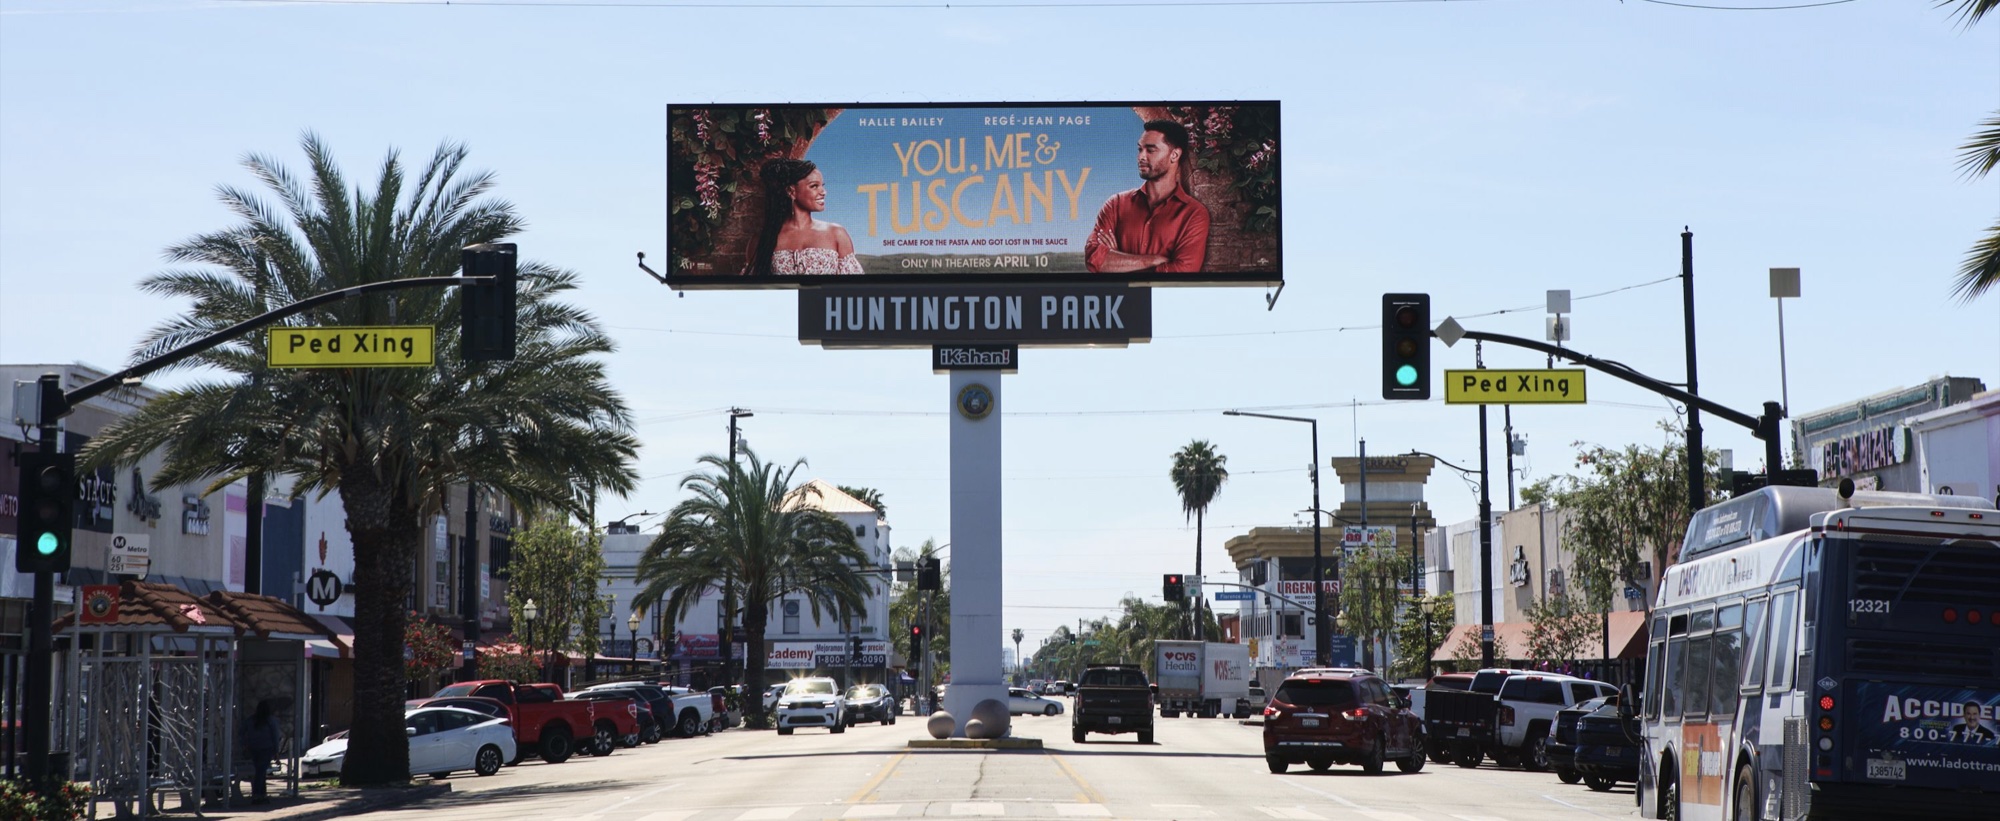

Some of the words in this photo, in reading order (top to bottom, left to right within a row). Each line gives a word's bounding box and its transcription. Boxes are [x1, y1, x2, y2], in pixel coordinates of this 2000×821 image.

[859, 117, 896, 127] HALLE
[902, 117, 944, 127] BAILEY
[984, 113, 1053, 126] REGÉ-JEAN
[1059, 116, 1091, 126] PAGE
[892, 137, 978, 178] YOU,
[856, 167, 1092, 237] TUSCANY
[1045, 238, 1068, 246] SAUCE
[901, 258, 929, 268] ONLY
[931, 258, 943, 268] IN
[945, 258, 991, 268] THEATERS
[993, 255, 1030, 267] APRIL
[1034, 255, 1049, 267] 10
[825, 296, 1022, 331] HUNTINGTON
[1040, 295, 1125, 330] PARK
[289, 333, 341, 354] Ped
[353, 333, 414, 358] Xing
[1463, 375, 1507, 393] Ped
[1517, 375, 1569, 398] Xing
[1364, 457, 1408, 469] ERRANO
[114, 537, 126, 548] M
[127, 545, 147, 554] Metro
[110, 564, 124, 572] 251
[312, 577, 336, 600] M
[1848, 599, 1890, 613] 12321
[768, 648, 813, 660] cademy
[867, 643, 885, 653] precio!
[1174, 652, 1196, 661] CVS
[1165, 661, 1196, 671] Health
[1218, 659, 1228, 680] CVS
[1869, 765, 1904, 779] 1385742
